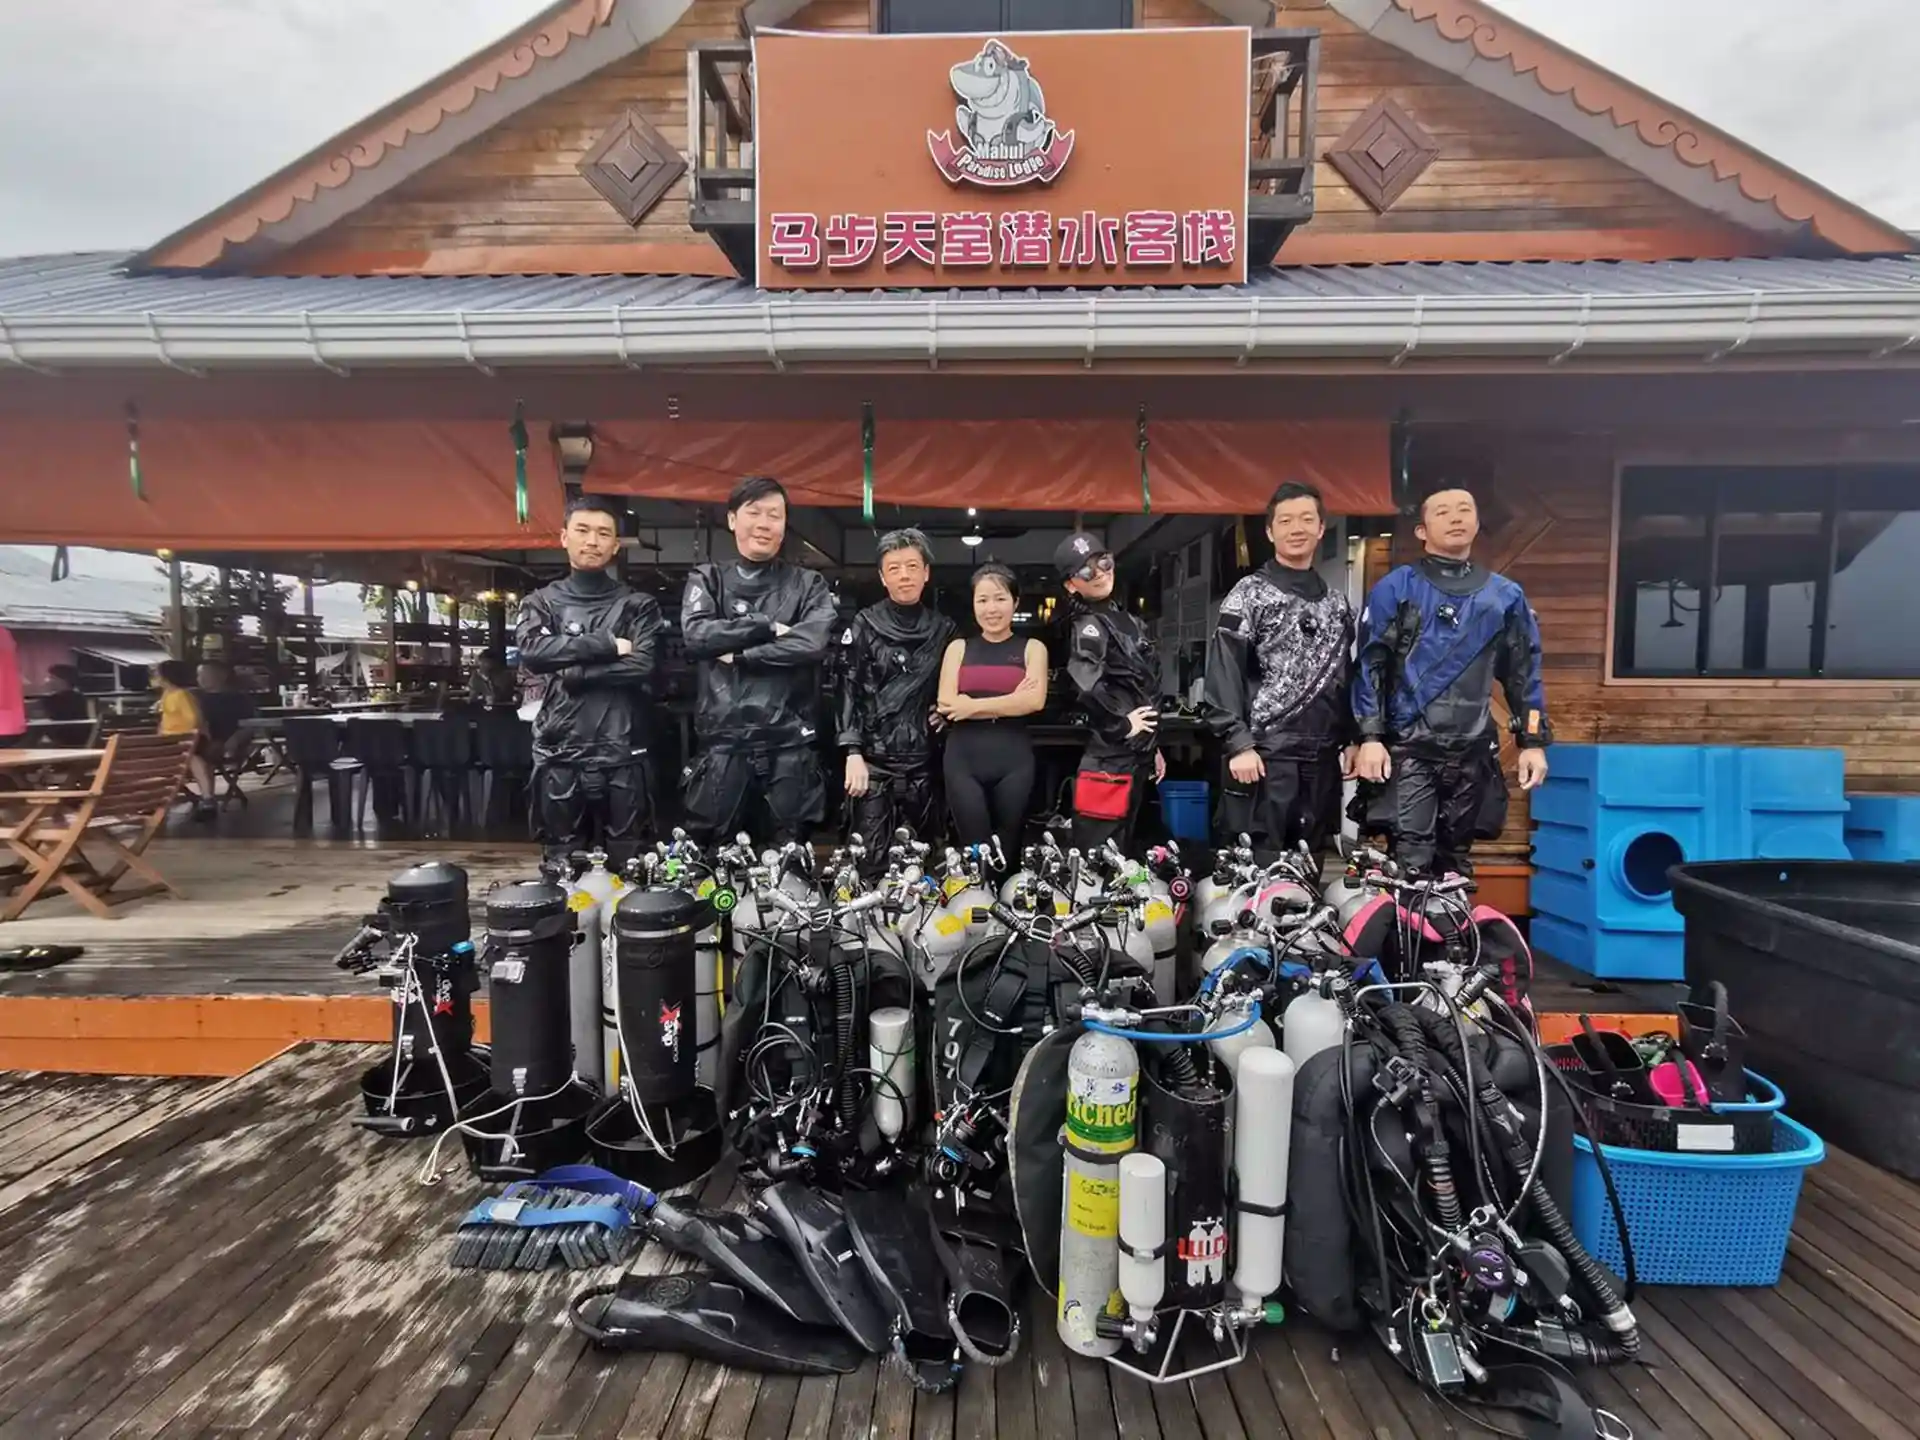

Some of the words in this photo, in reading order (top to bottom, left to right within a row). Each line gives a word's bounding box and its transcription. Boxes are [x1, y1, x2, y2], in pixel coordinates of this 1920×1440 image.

[956, 152, 1007, 179] Paradise
[1008, 155, 1045, 179] Lodge
[976, 142, 1025, 160] Mabul
[768, 211, 1236, 267] 马步天堂潜水客栈
[942, 1016, 963, 1080] 707
